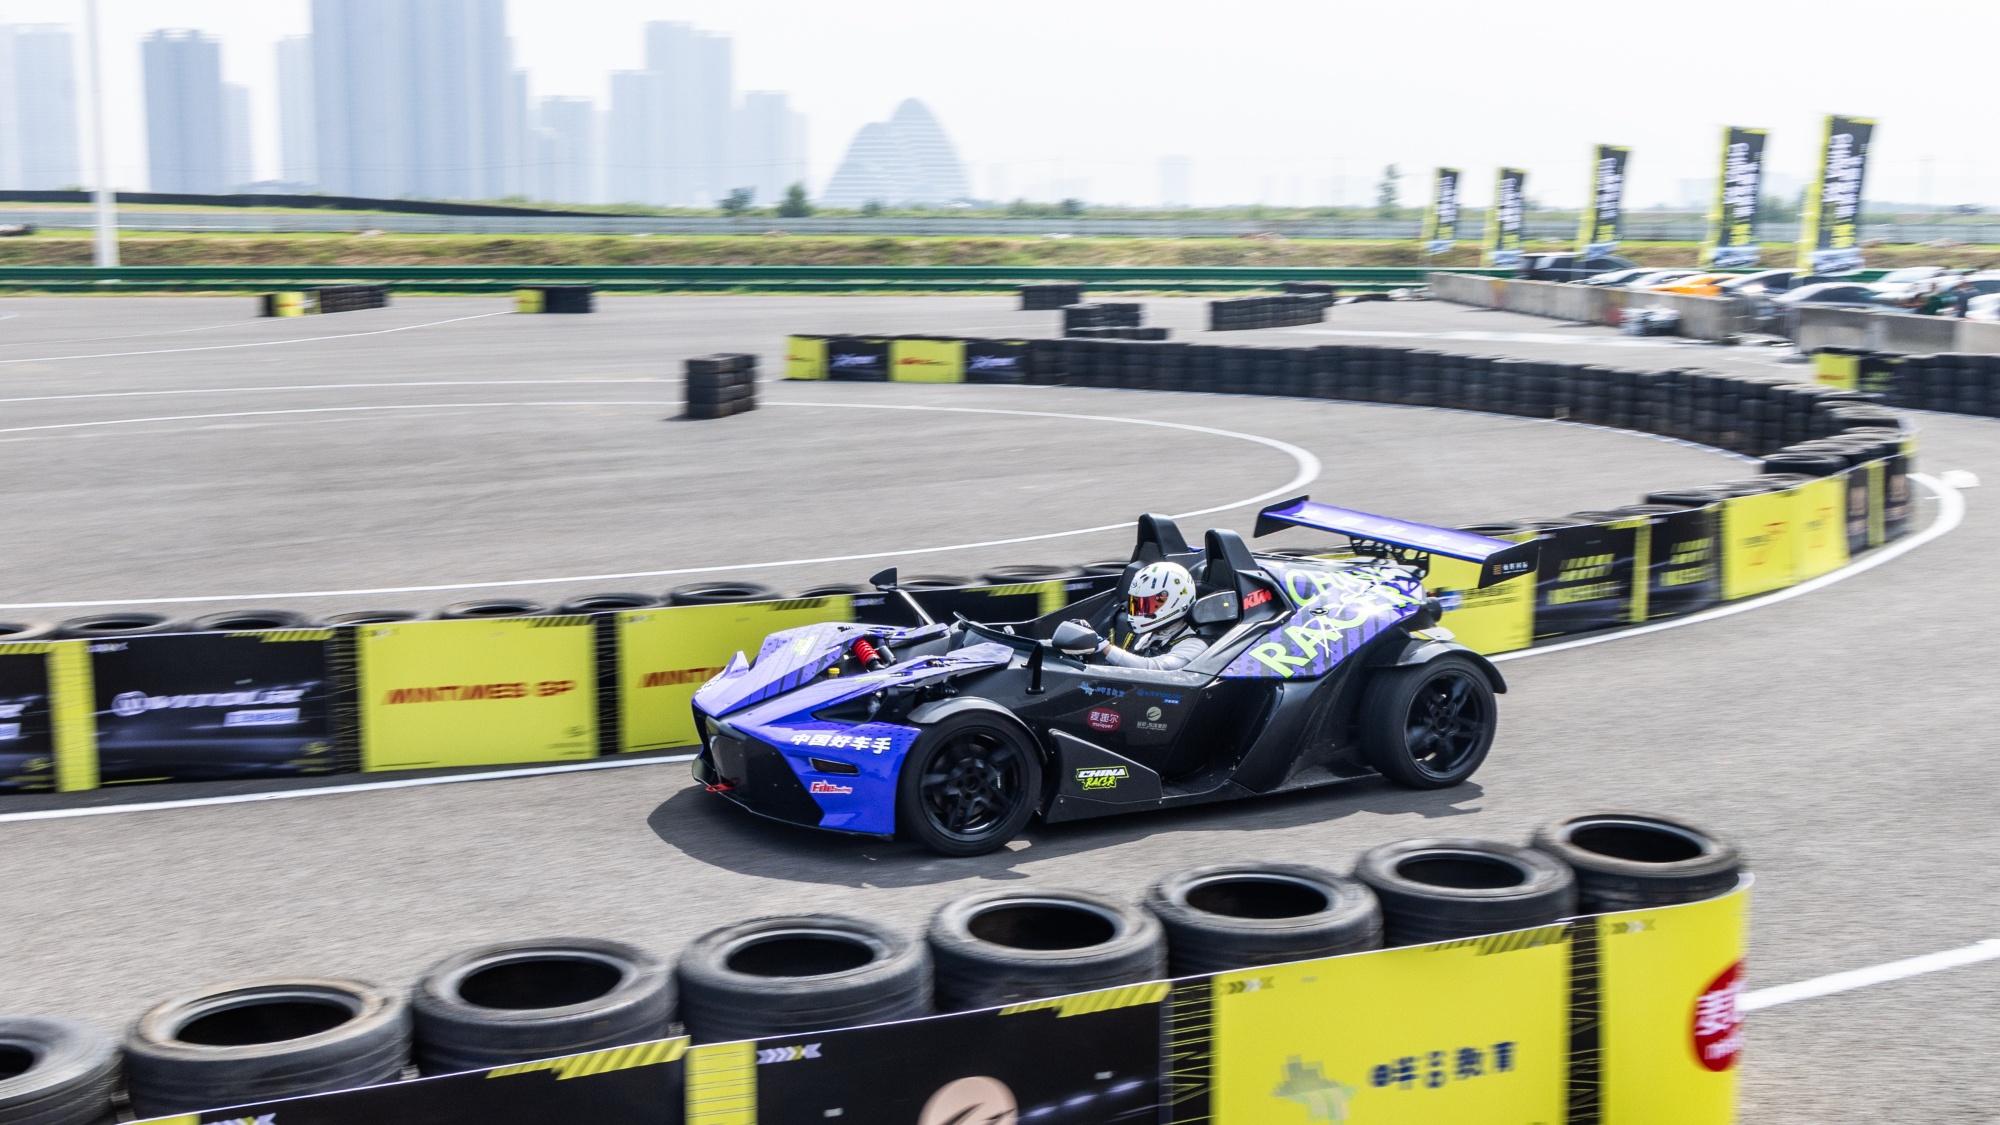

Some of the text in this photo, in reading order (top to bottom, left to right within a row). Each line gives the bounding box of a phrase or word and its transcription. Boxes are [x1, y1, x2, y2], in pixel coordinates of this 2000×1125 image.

[1243, 588, 1272, 610] KTM
[790, 733, 892, 755] 中国好车手
[1078, 768, 1126, 778] CHINA
